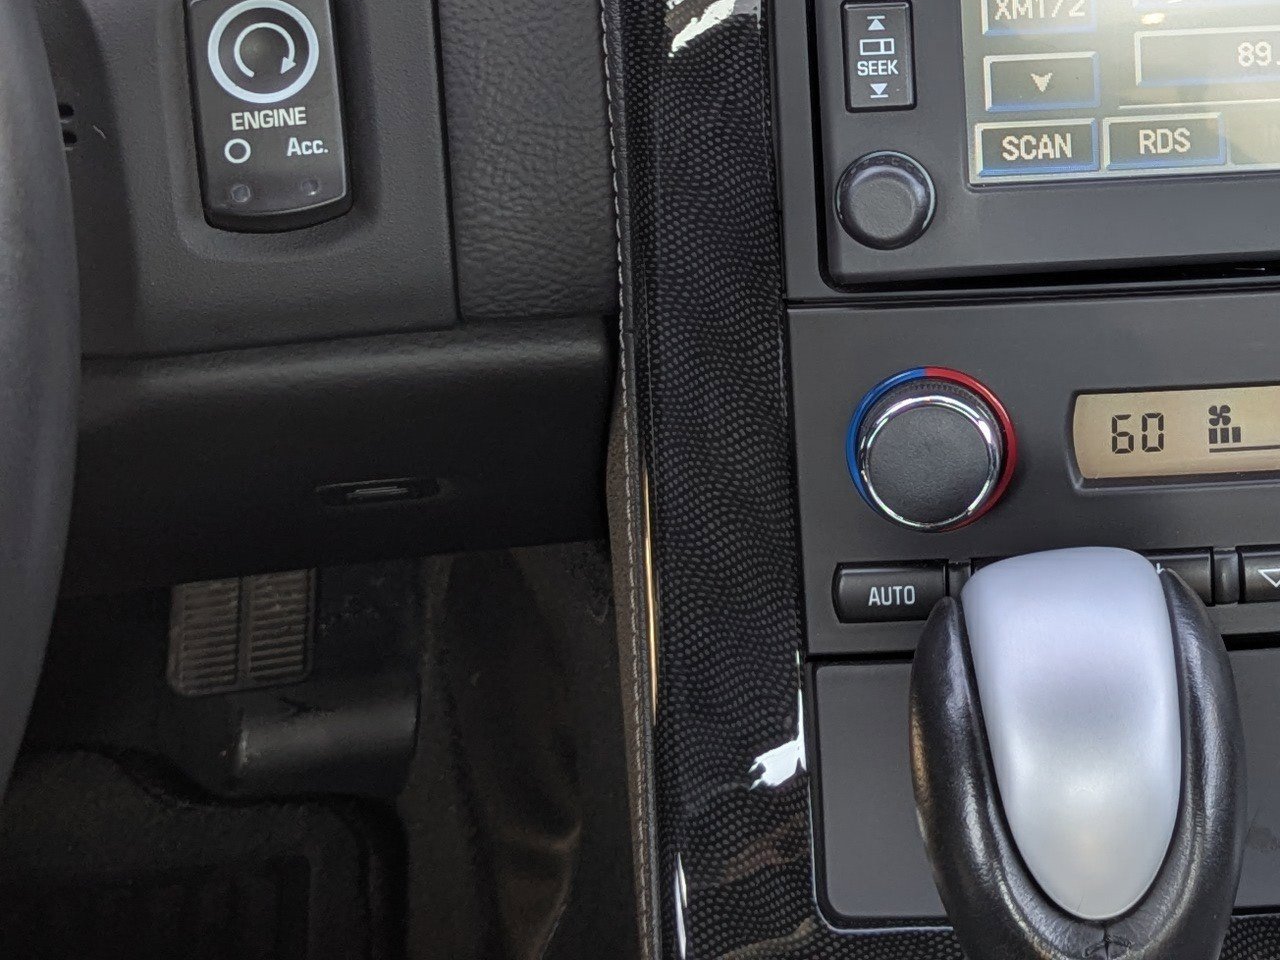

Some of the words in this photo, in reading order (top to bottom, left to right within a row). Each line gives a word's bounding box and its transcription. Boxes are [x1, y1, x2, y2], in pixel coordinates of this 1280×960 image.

[857, 59, 899, 76] SEEK
[231, 107, 307, 131] ENGINE
[286, 137, 329, 157] Acc.
[1002, 133, 1072, 161] SCAN
[1139, 128, 1191, 155] RDS
[1111, 412, 1165, 455] 60
[868, 585, 916, 606] AUTO
